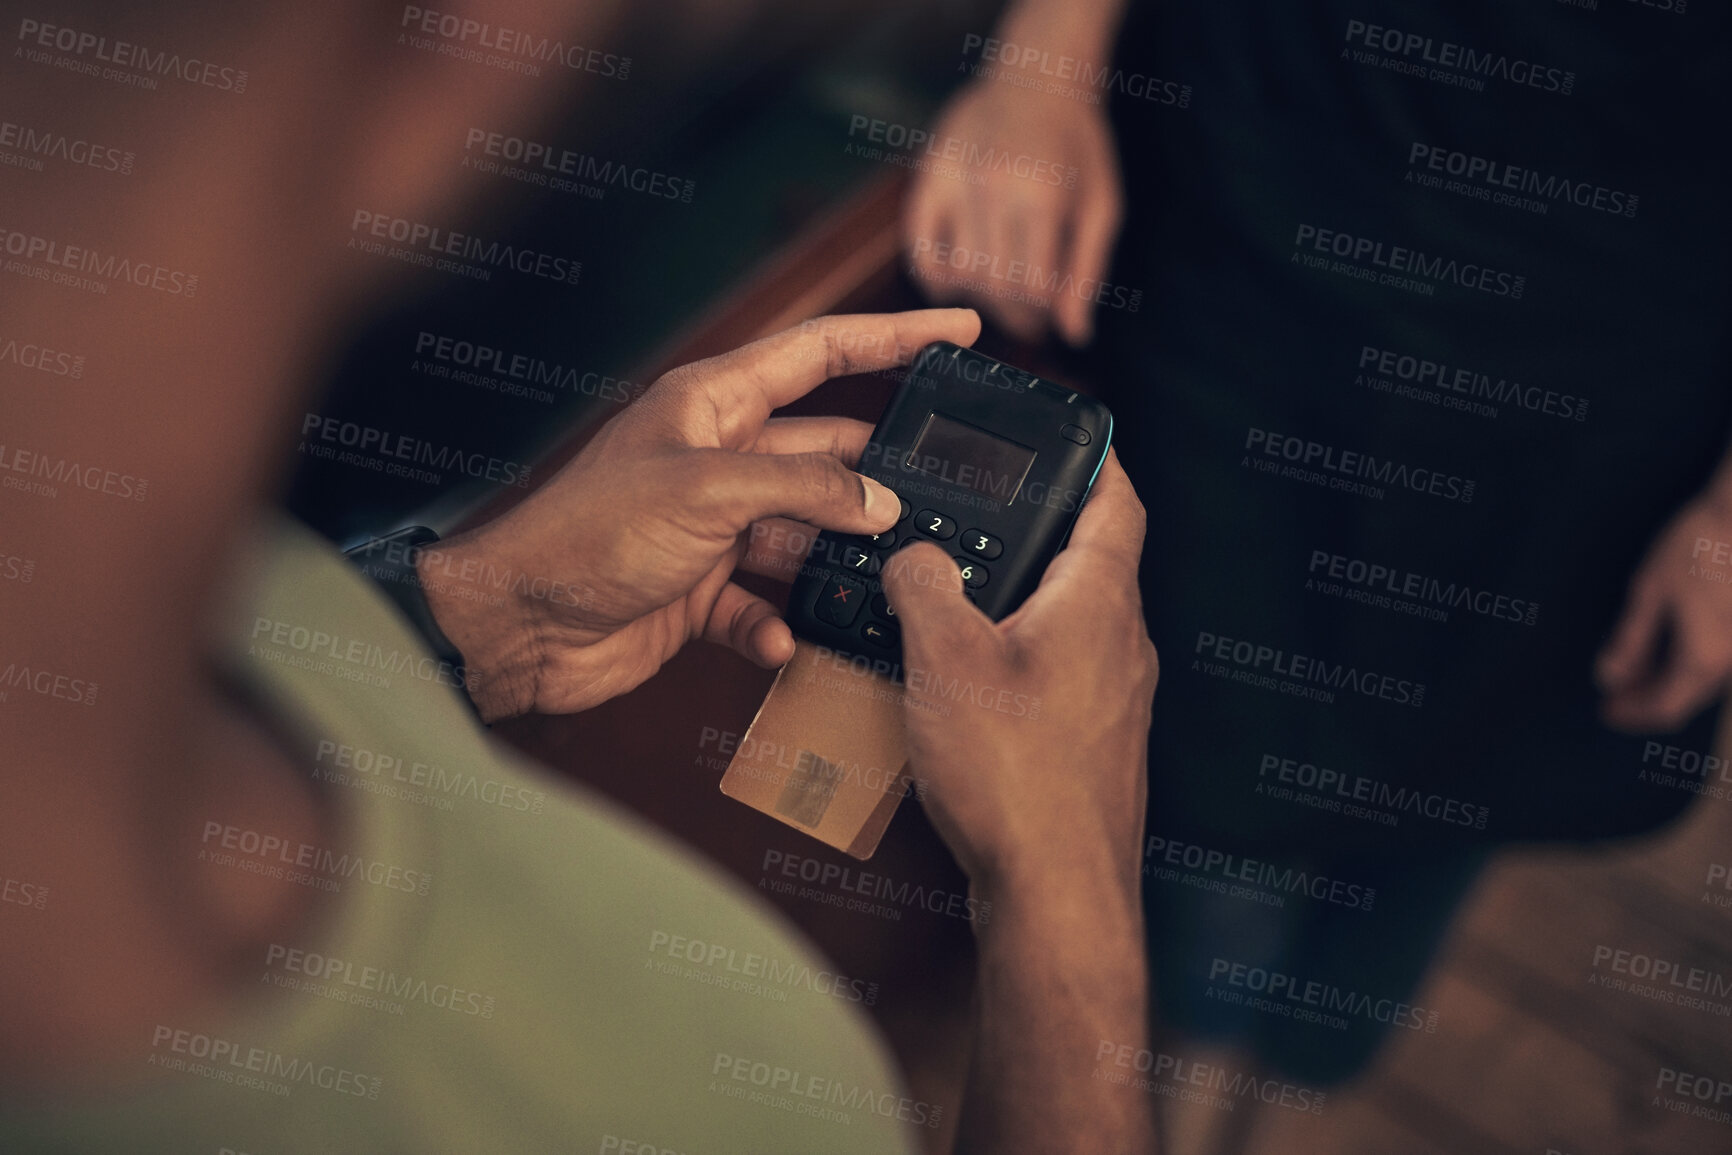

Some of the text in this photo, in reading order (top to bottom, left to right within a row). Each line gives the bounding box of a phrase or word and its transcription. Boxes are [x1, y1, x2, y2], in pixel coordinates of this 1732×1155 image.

[929, 517, 942, 531] 2
[975, 536, 989, 550] 3
[856, 554, 868, 567] 7
[961, 566, 973, 580] 6
